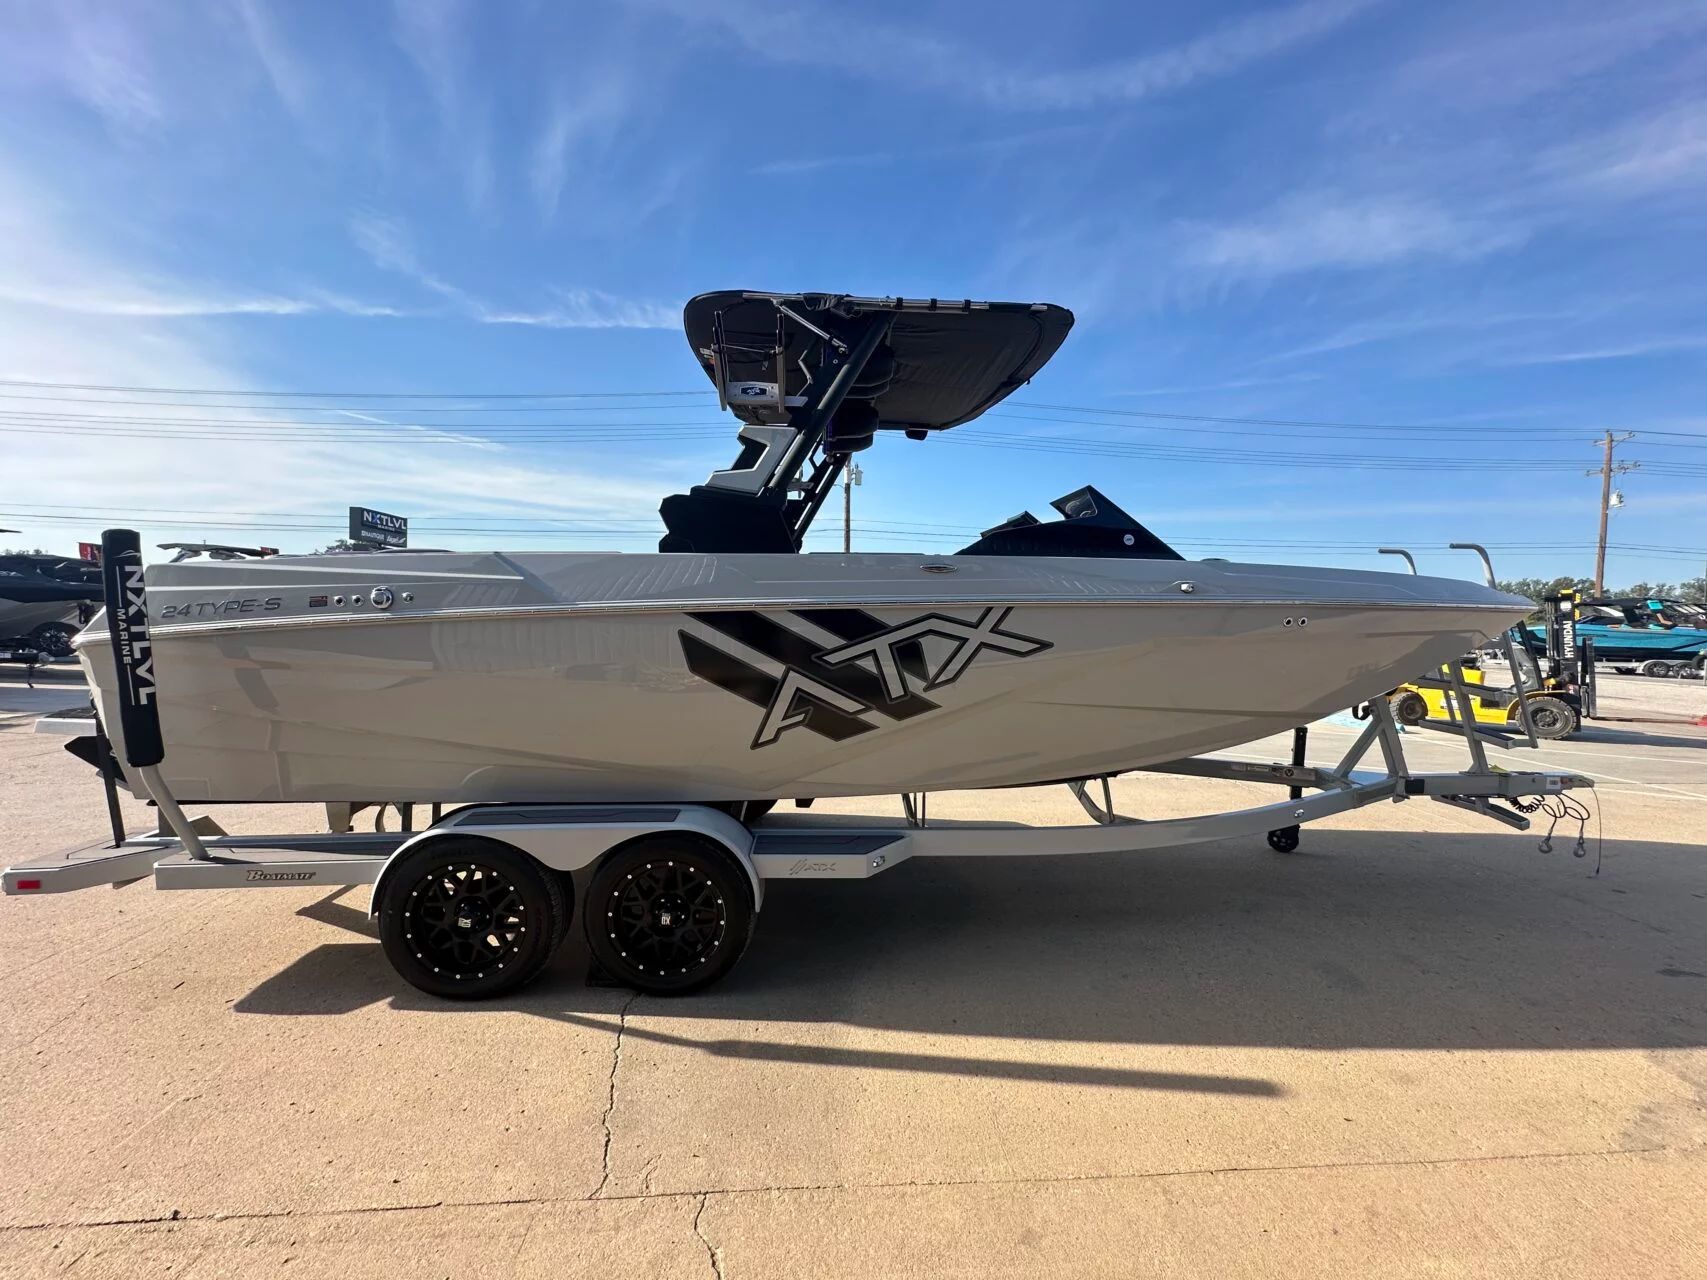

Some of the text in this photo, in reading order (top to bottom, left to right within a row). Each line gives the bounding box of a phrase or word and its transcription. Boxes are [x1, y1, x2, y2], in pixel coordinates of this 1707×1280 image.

[363, 510, 407, 530] NXTLVL
[161, 597, 283, 619] 24 TYPE-S
[116, 608, 132, 664] MARINE
[125, 565, 156, 705] NXTLVL
[1563, 620, 1574, 658] HYUNDAI
[749, 605, 1055, 751] ATX
